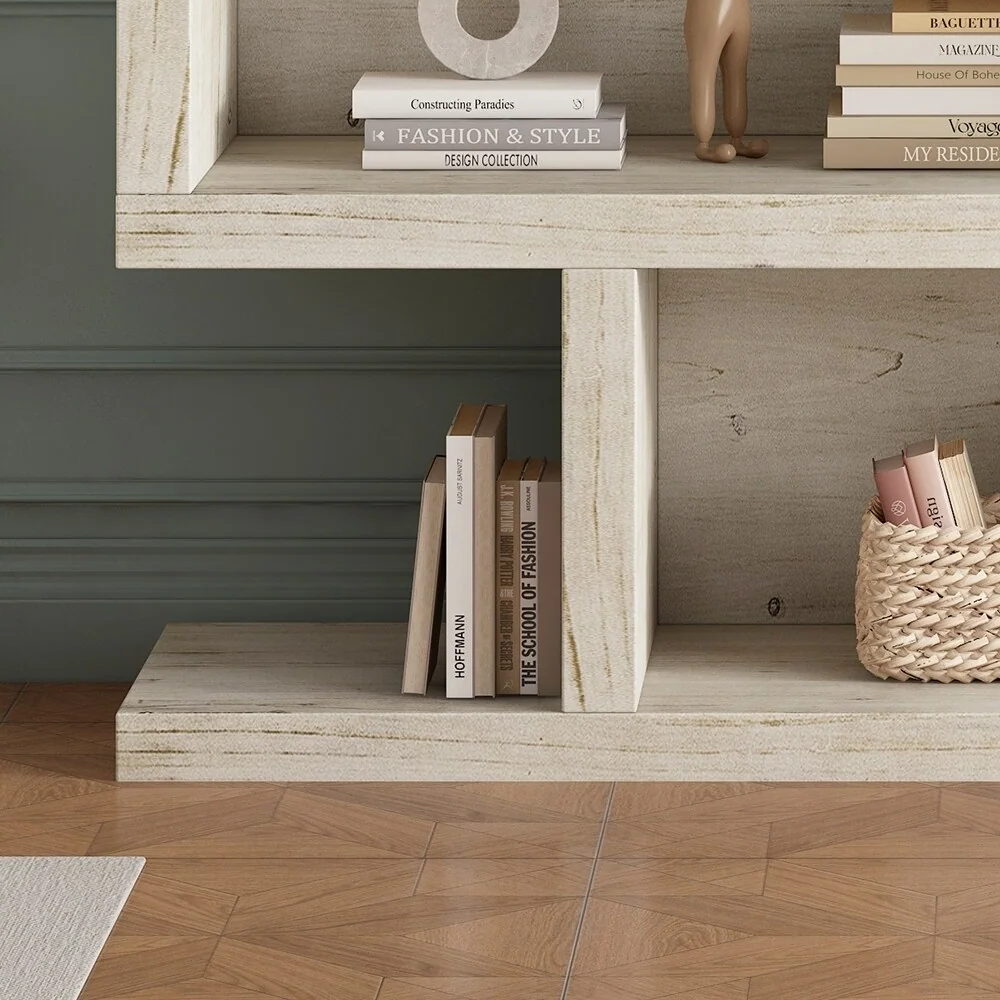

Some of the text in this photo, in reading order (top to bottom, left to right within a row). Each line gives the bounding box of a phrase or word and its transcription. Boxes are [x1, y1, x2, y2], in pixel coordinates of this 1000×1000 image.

[939, 44, 1000, 57] MAGAZINE
[916, 70, 952, 80] House
[954, 70, 969, 80] Of
[410, 98, 515, 113] Constructing Paradies
[397, 127, 601, 144] FASHION & STYLE
[444, 153, 538, 167] DESIGN COLLECTION
[903, 146, 933, 162] MY
[500, 500, 514, 533] ROWLING
[521, 521, 537, 688] THE SCHOOL OF FASHION
[454, 614, 466, 679] HOFFMANN
